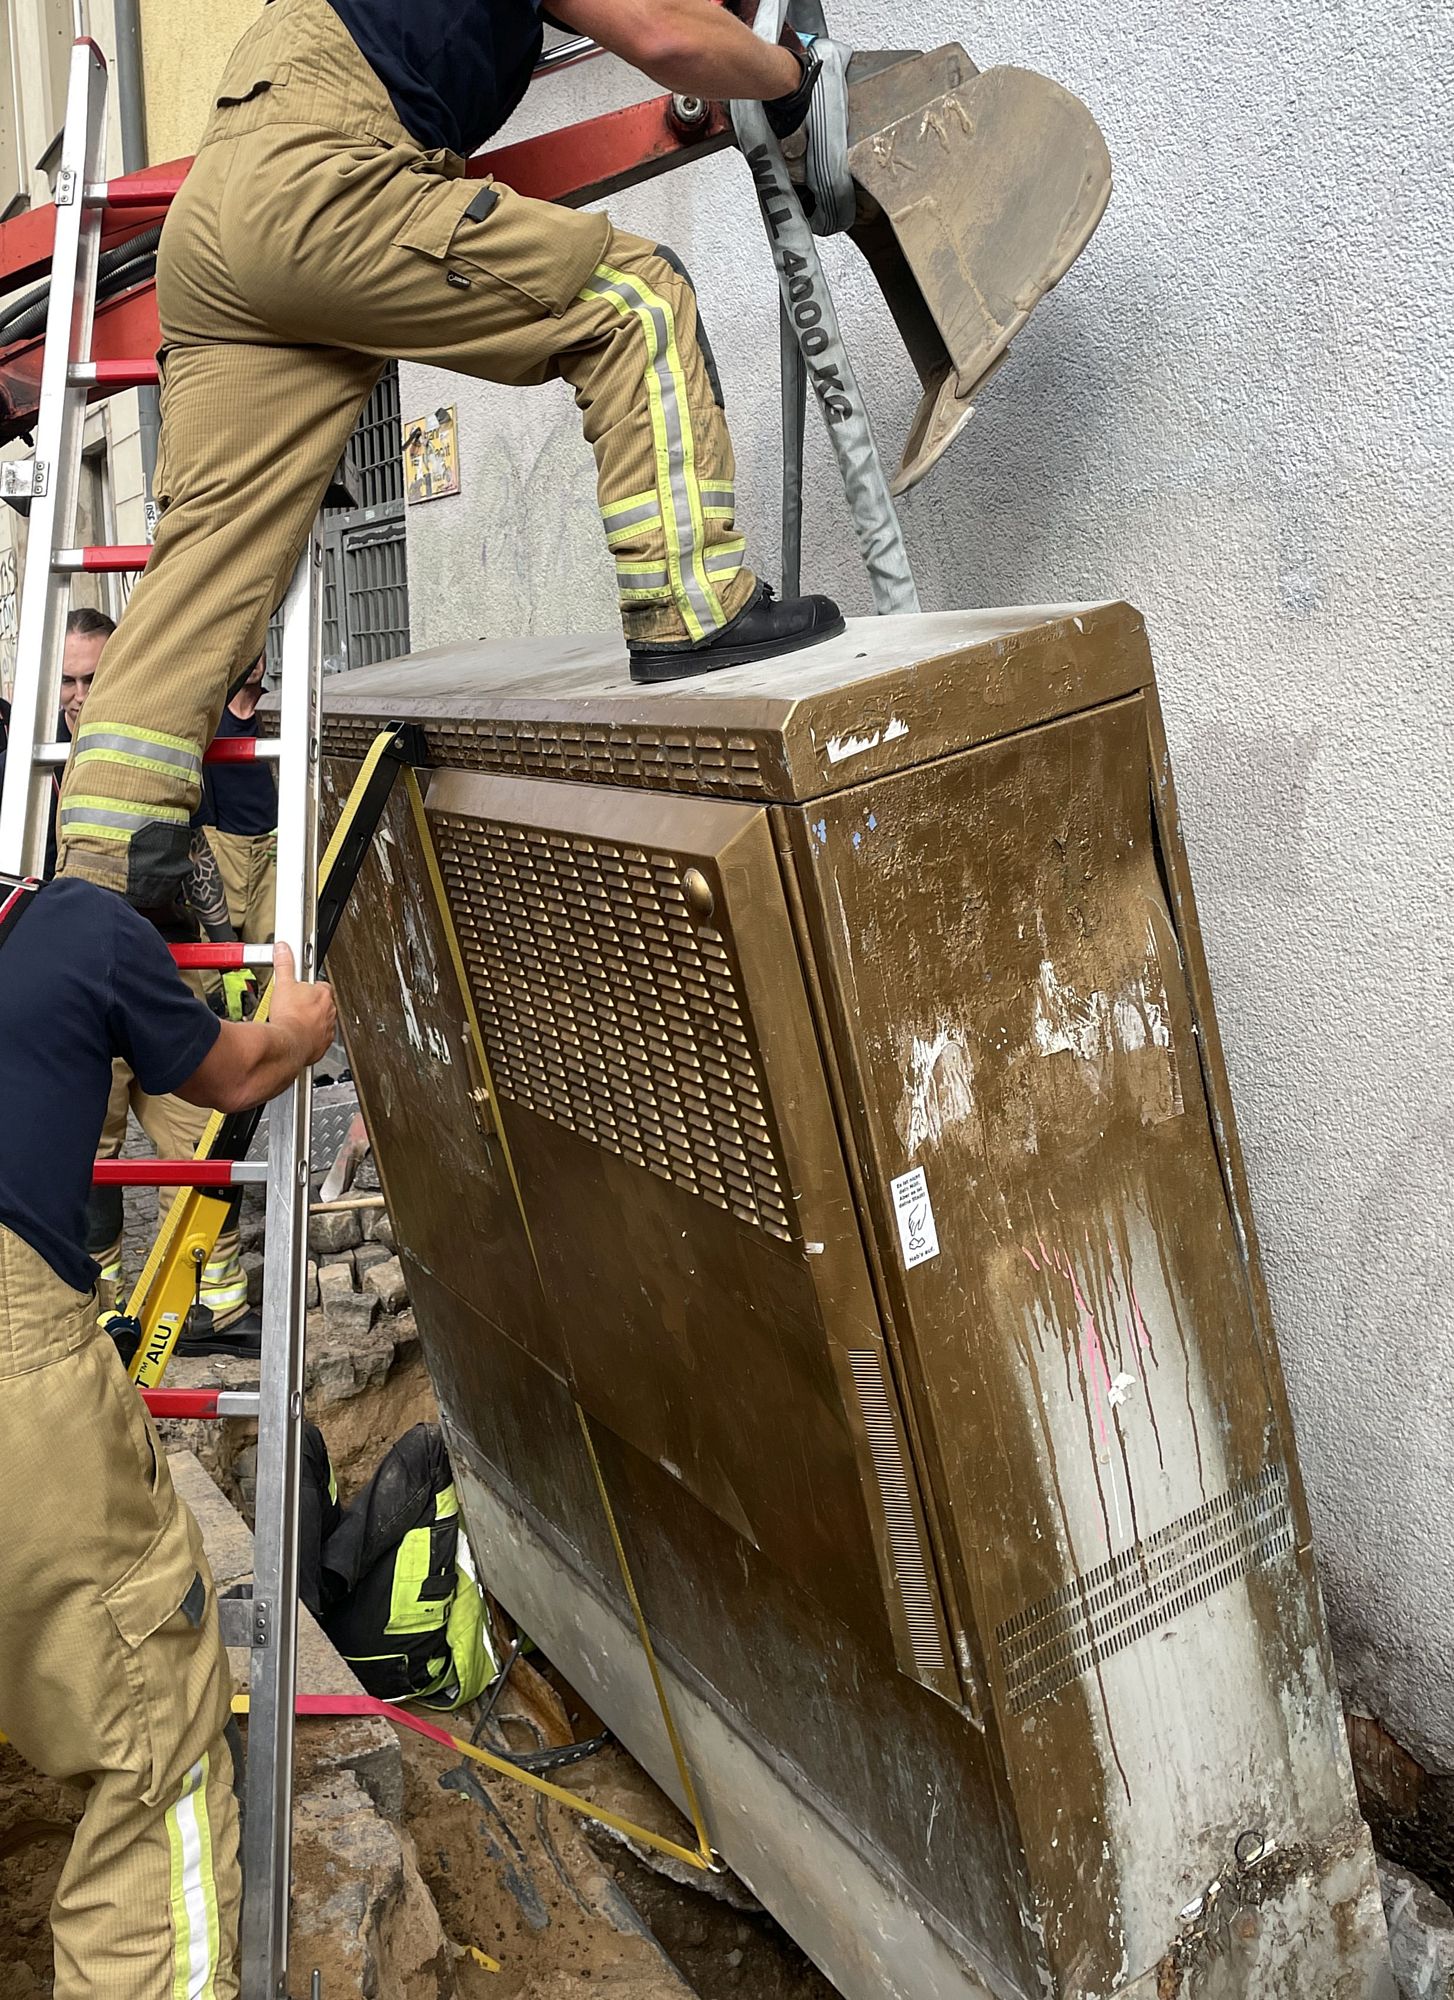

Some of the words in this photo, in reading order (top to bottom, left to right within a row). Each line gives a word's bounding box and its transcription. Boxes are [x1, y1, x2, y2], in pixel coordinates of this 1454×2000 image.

[749, 143, 792, 240] WLL
[782, 250, 829, 356] 4000
[812, 363, 853, 425] KG
[146, 1325, 172, 1365] ALU
